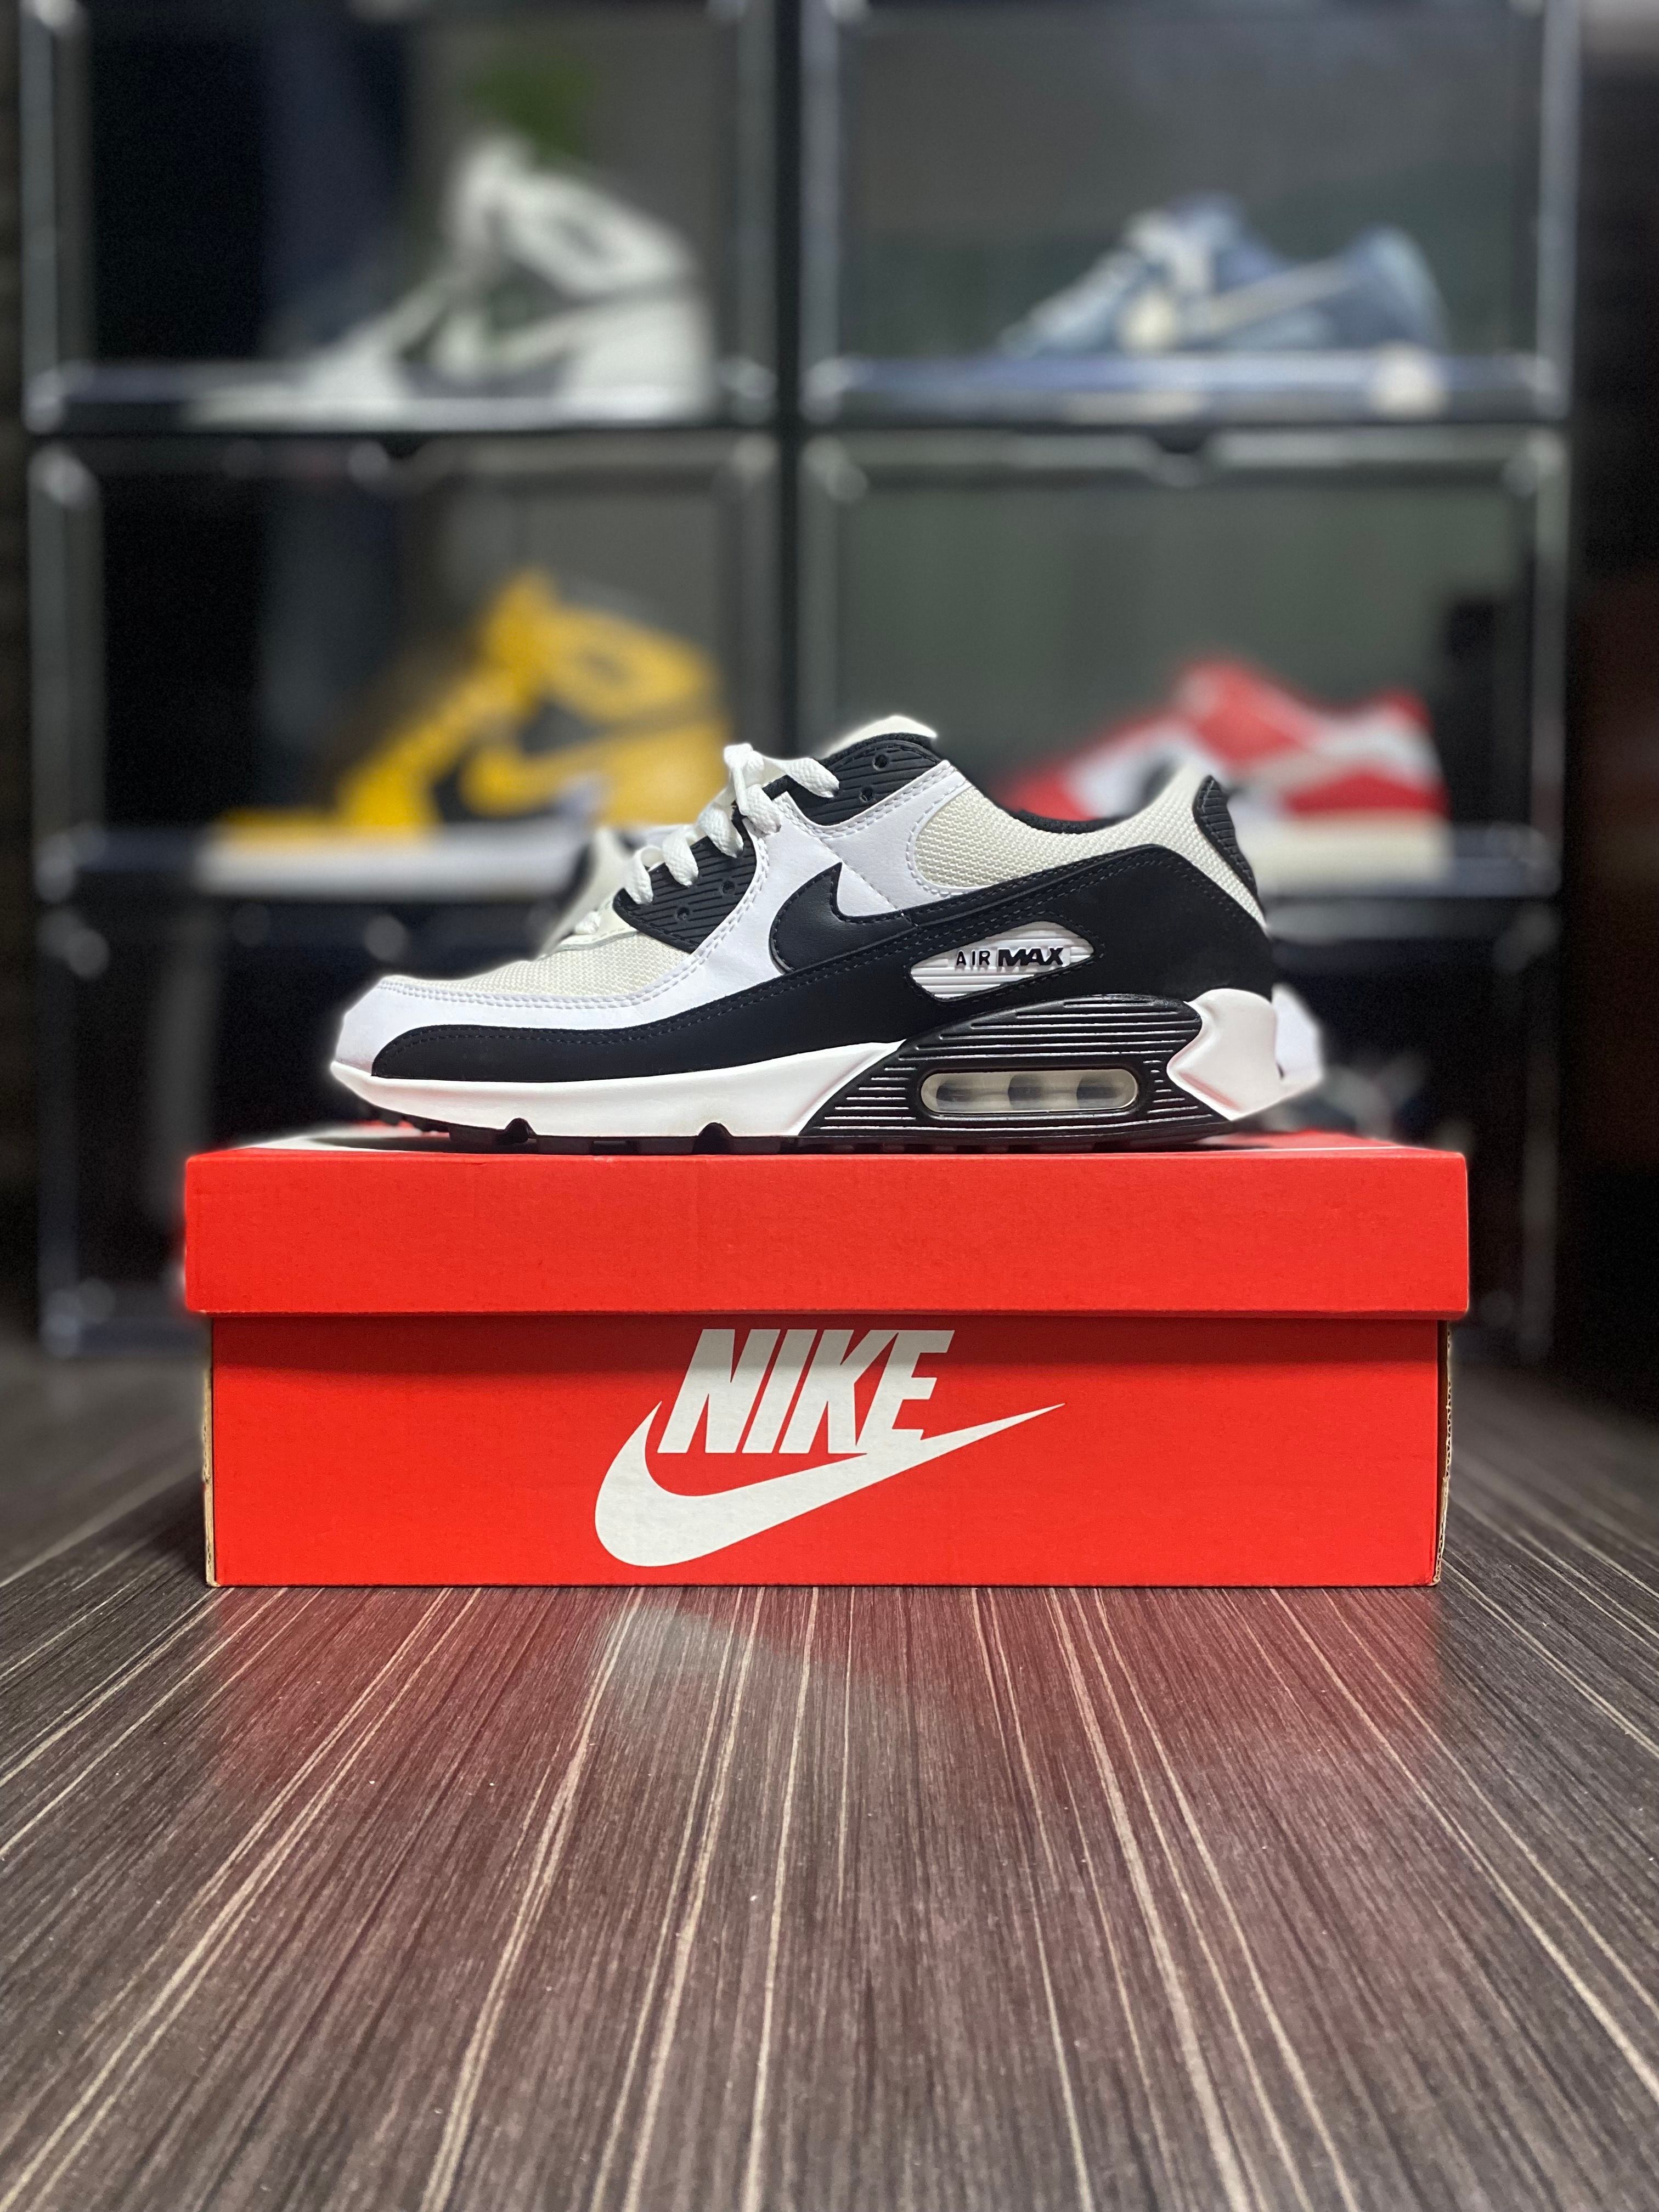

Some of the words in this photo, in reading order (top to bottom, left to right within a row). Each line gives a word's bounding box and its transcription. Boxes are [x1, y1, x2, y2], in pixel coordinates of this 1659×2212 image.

[956, 950, 990, 966] AIR
[998, 947, 1064, 967] MAX
[657, 1328, 955, 1454] NIKE
